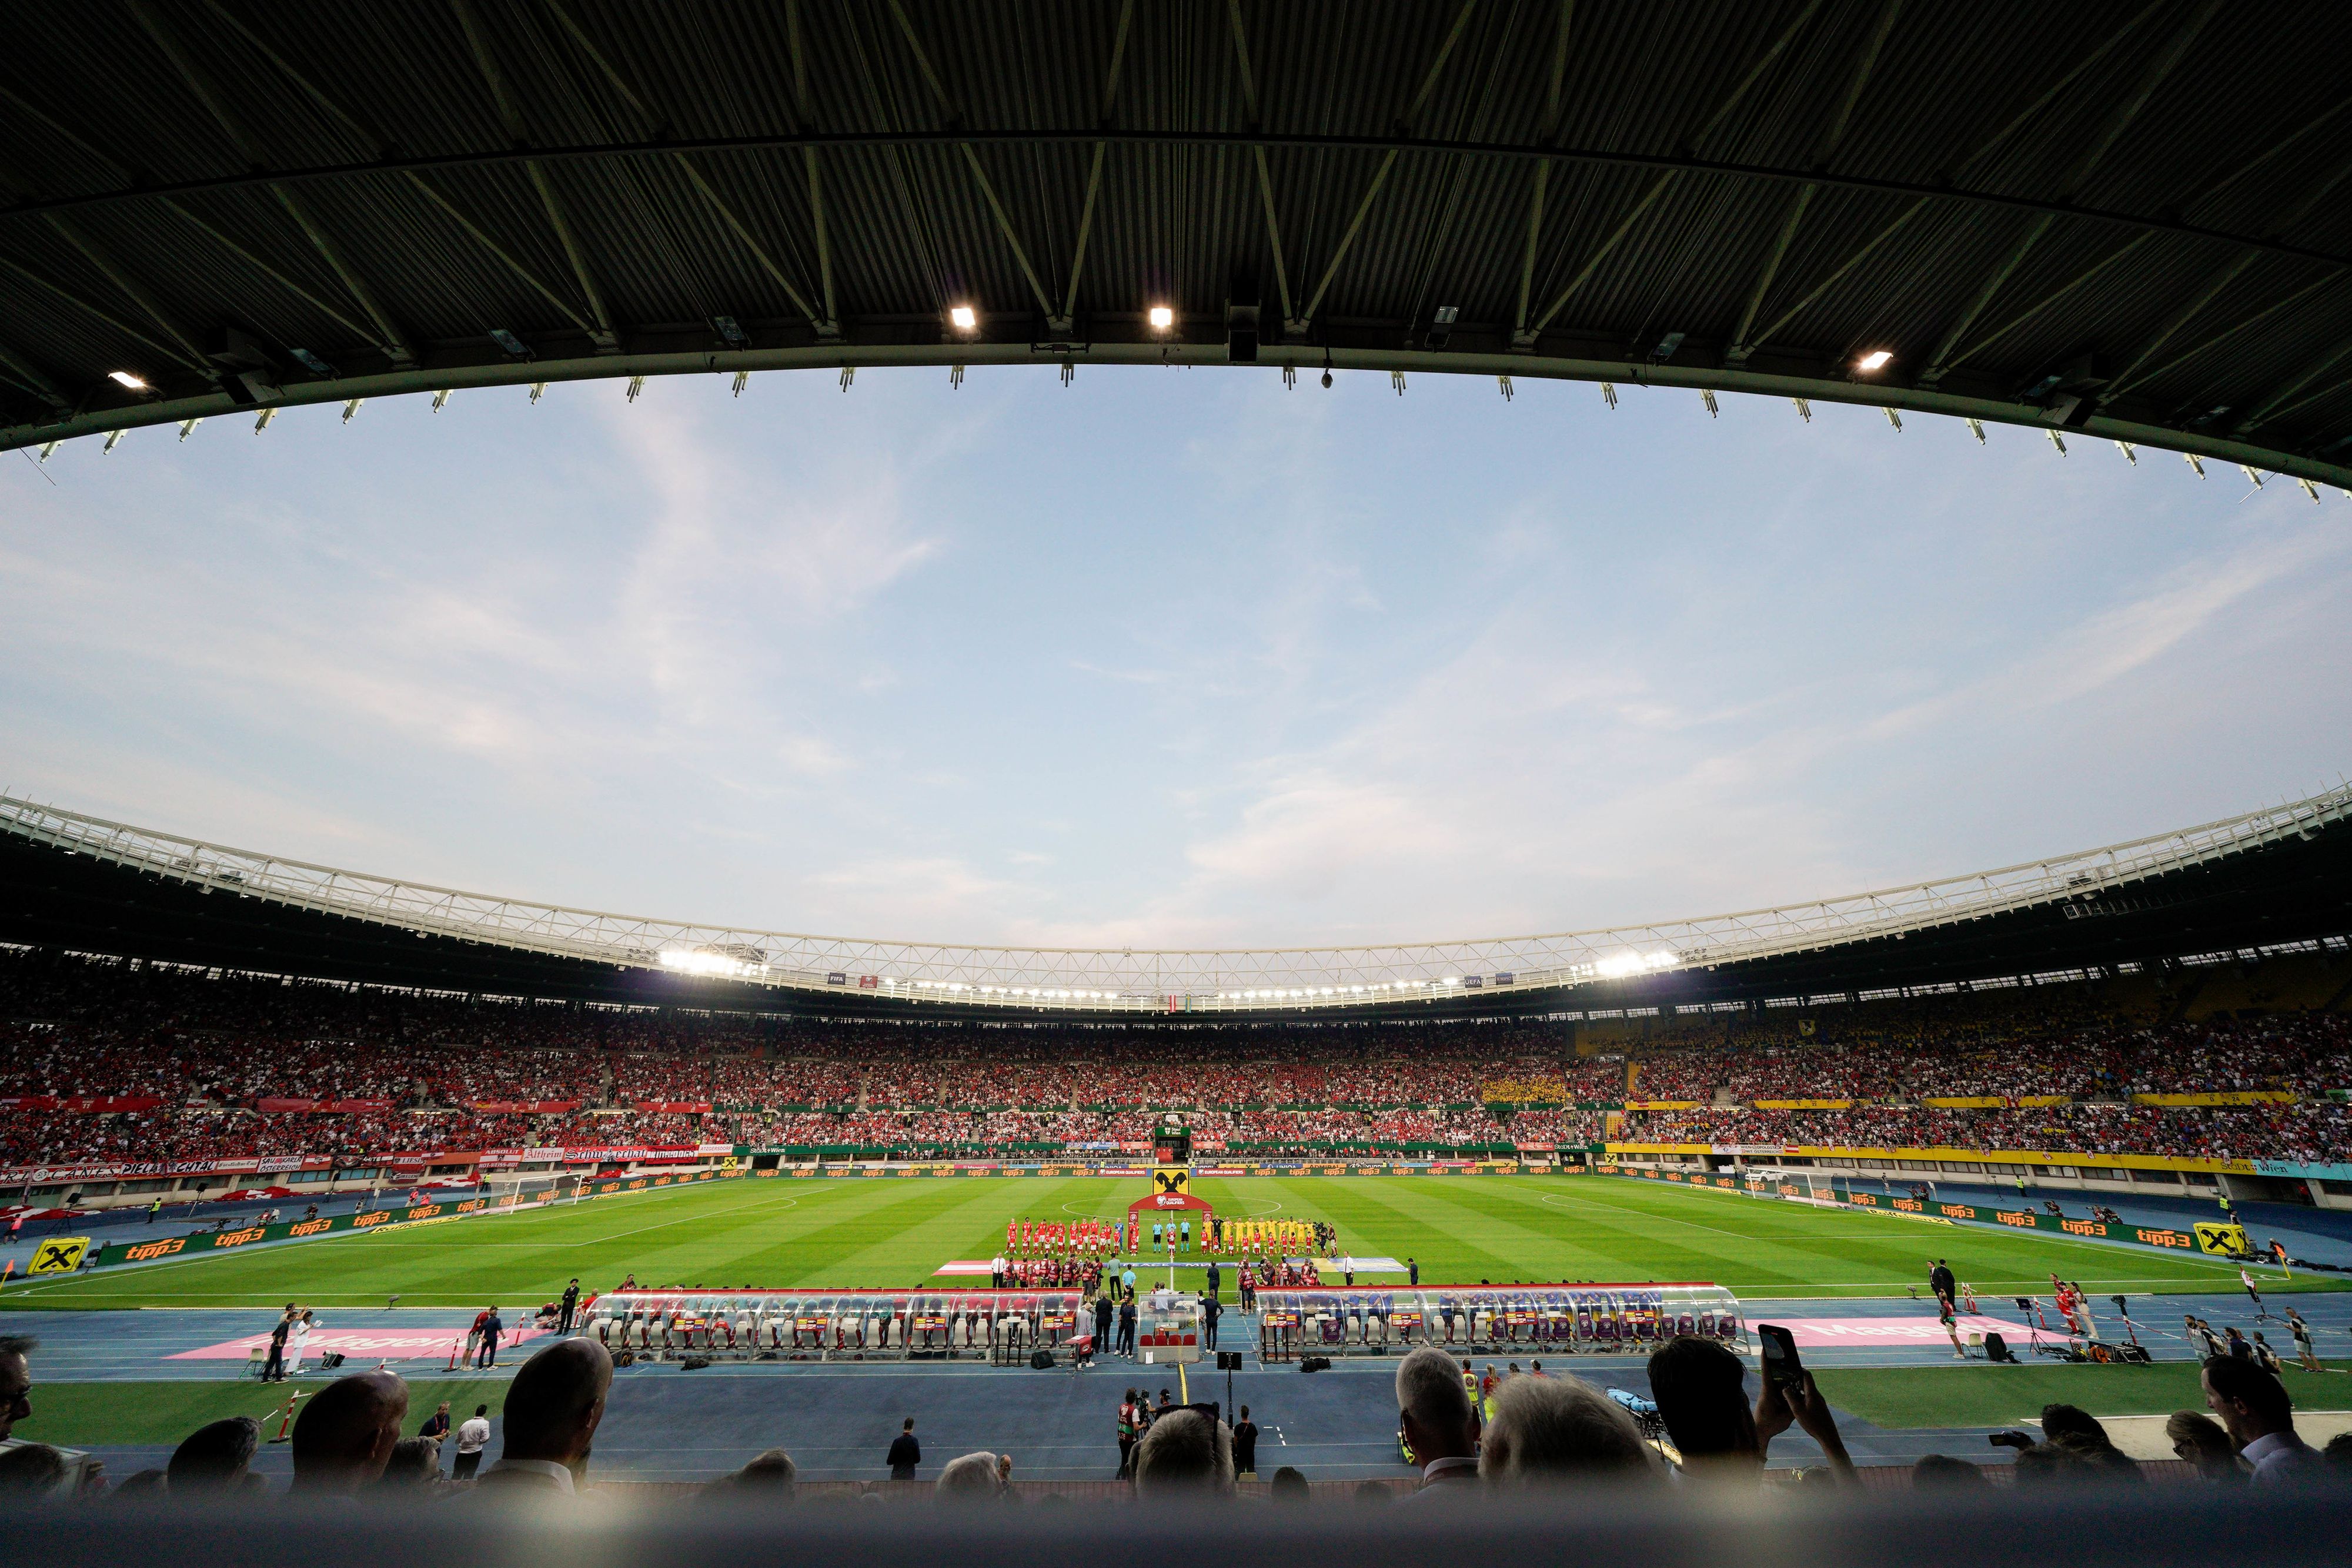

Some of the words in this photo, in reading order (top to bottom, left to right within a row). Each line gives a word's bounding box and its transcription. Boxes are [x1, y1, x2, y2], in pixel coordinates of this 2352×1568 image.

[524, 1149, 562, 1161] Altheim
[51, 1165, 118, 1181] CANES
[260, 1164, 301, 1172] ÖSTERREICH
[792, 1169, 814, 1177] tipp3
[933, 1168, 955, 1176] tipp3
[1038, 1168, 1059, 1176] tipp3
[1073, 1168, 1094, 1176] tipp3
[1598, 1165, 1618, 1174] tipp3
[2260, 1164, 2288, 1173] Wien
[602, 1183, 620, 1192] tipp3
[1716, 1178, 1734, 1187] tipp3
[1850, 1194, 1876, 1205] tipp3
[1893, 1199, 1922, 1211] tipp3
[409, 1205, 441, 1219] tipp3
[1941, 1205, 1975, 1218] tipp3
[353, 1211, 390, 1227] tipp3
[1996, 1212, 2035, 1226] tipp3
[290, 1219, 332, 1236] tipp3
[2062, 1221, 2106, 1236] tipp3
[215, 1228, 265, 1246] tipp3
[2137, 1230, 2190, 1247] tipp3
[126, 1239, 185, 1260] tipp3
